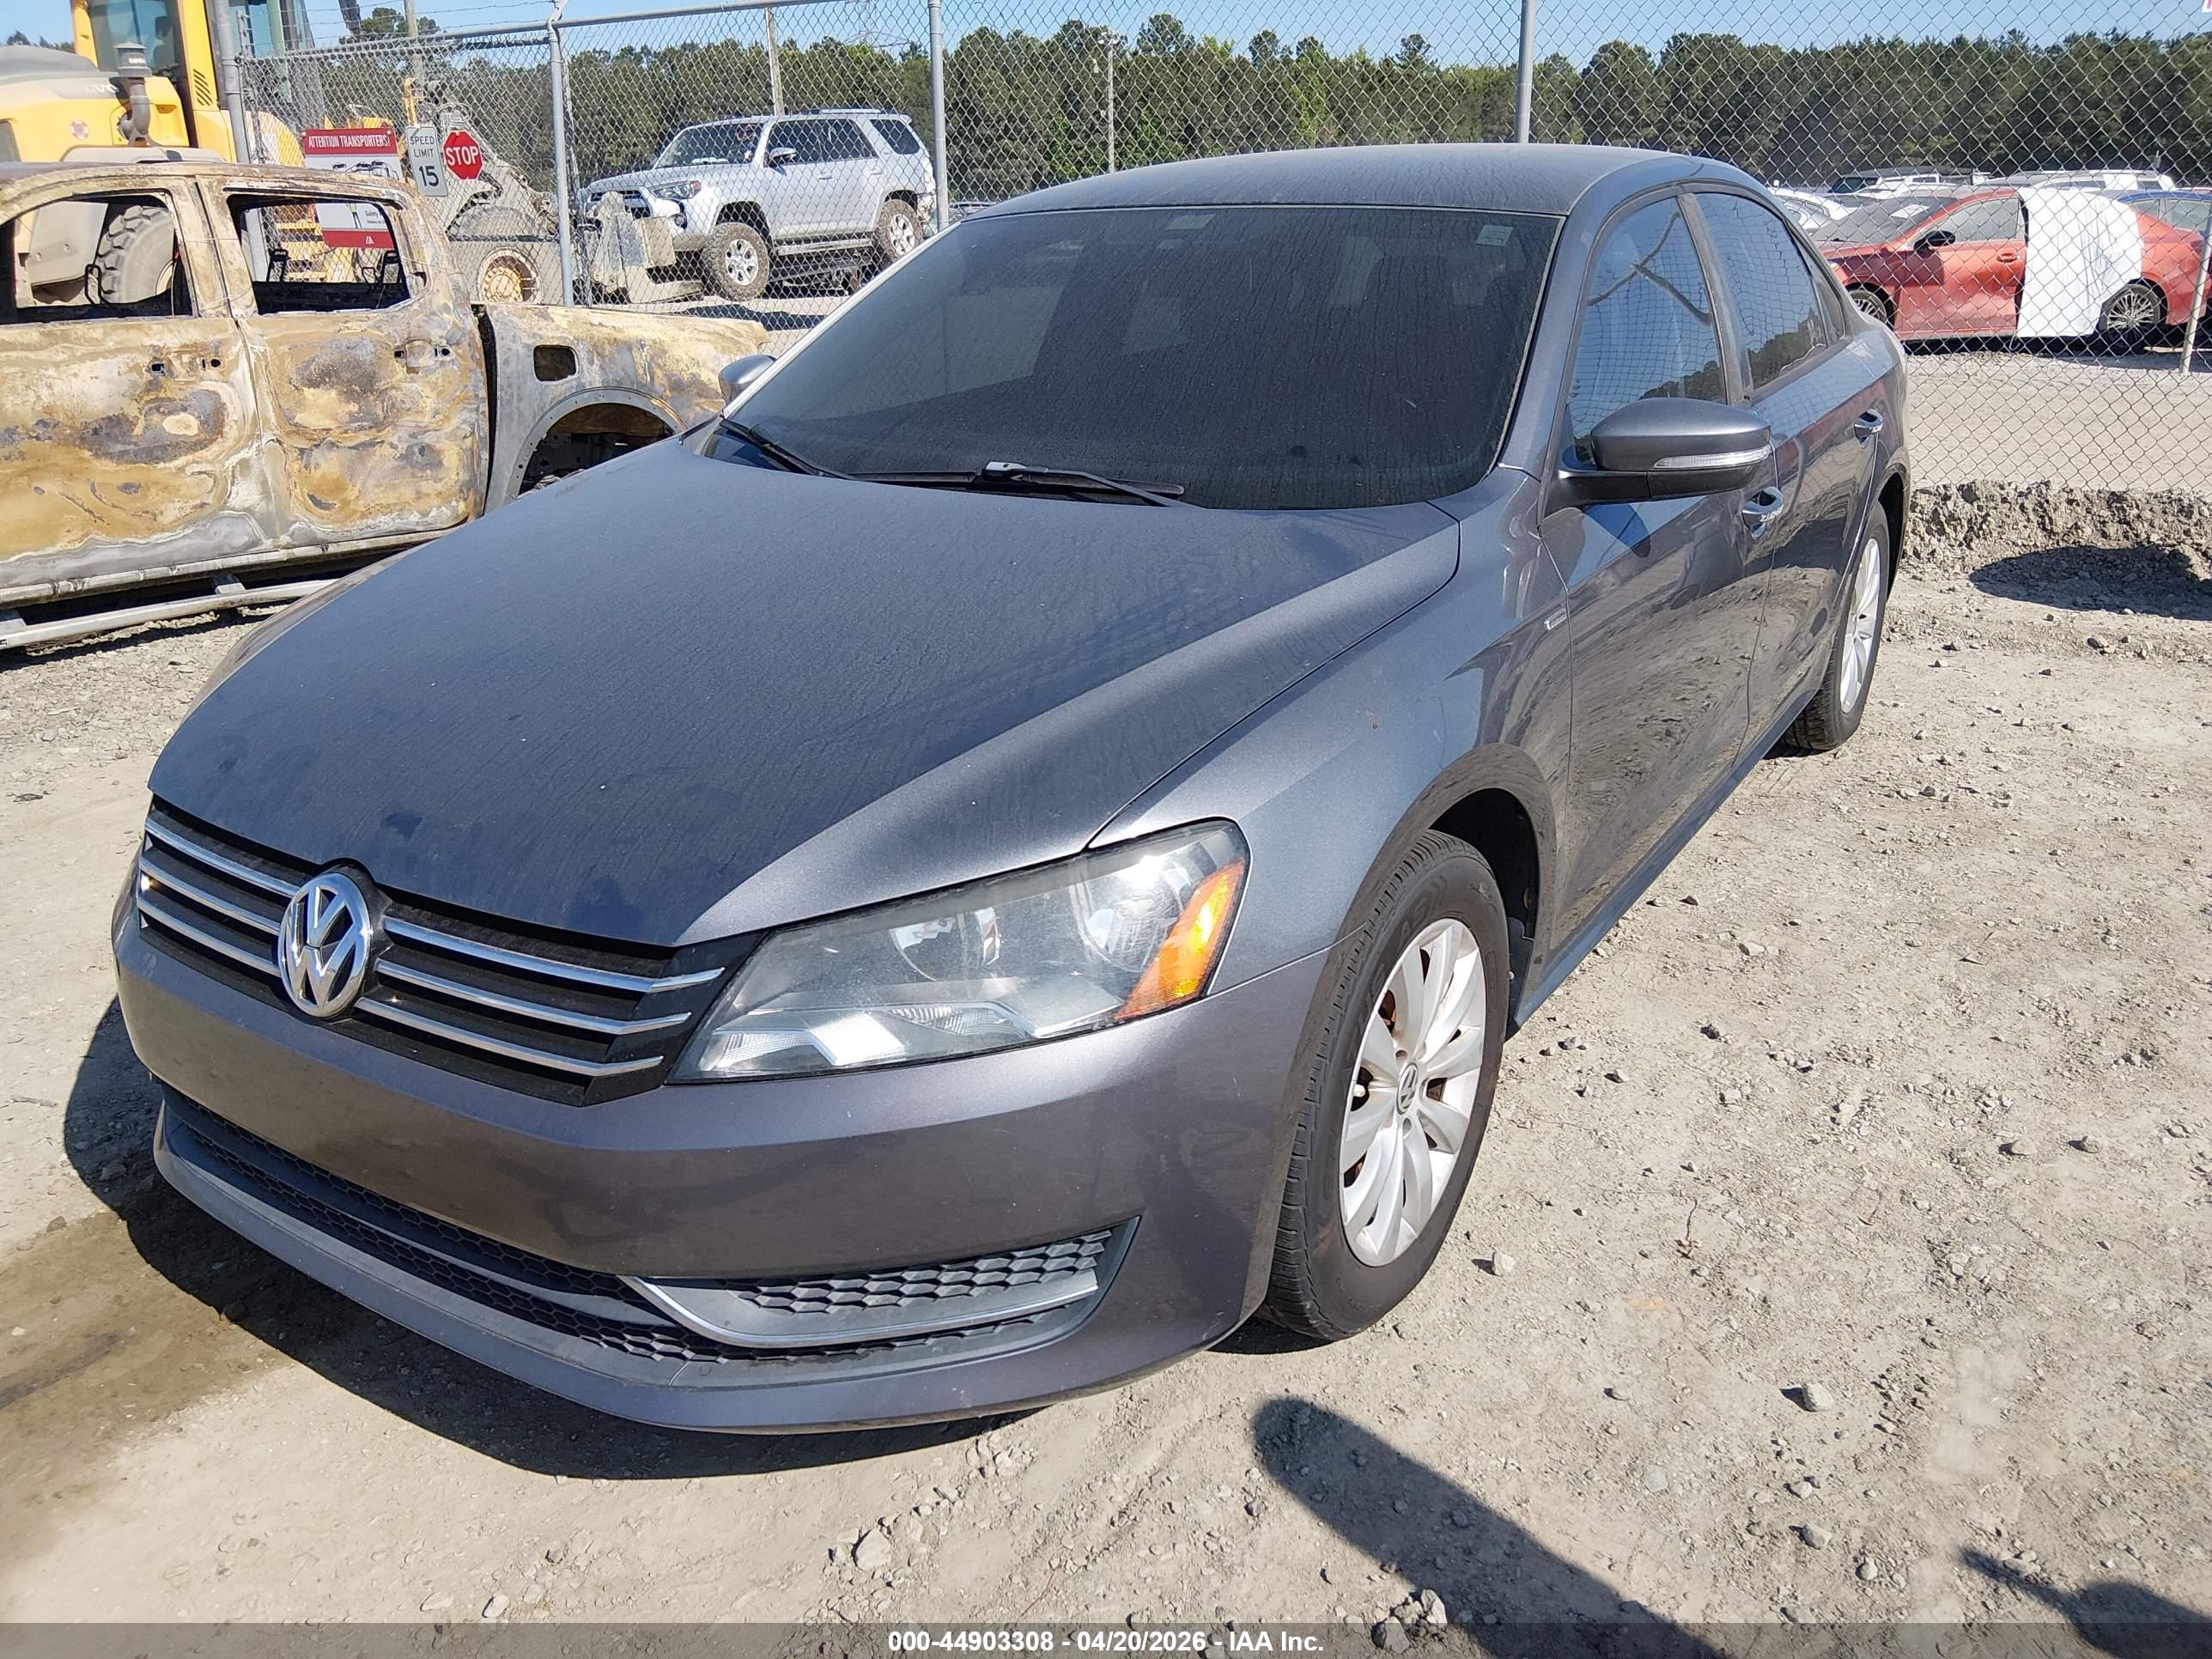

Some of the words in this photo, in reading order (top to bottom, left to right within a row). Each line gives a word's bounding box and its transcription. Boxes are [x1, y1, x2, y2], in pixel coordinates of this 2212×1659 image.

[308, 136, 339, 148] ATTENTION
[340, 135, 391, 148] TRANSPORTERS!
[410, 136, 435, 145] SPEED
[413, 149, 434, 158] LIMIT
[446, 146, 479, 166] STOP
[418, 165, 440, 187] 15
